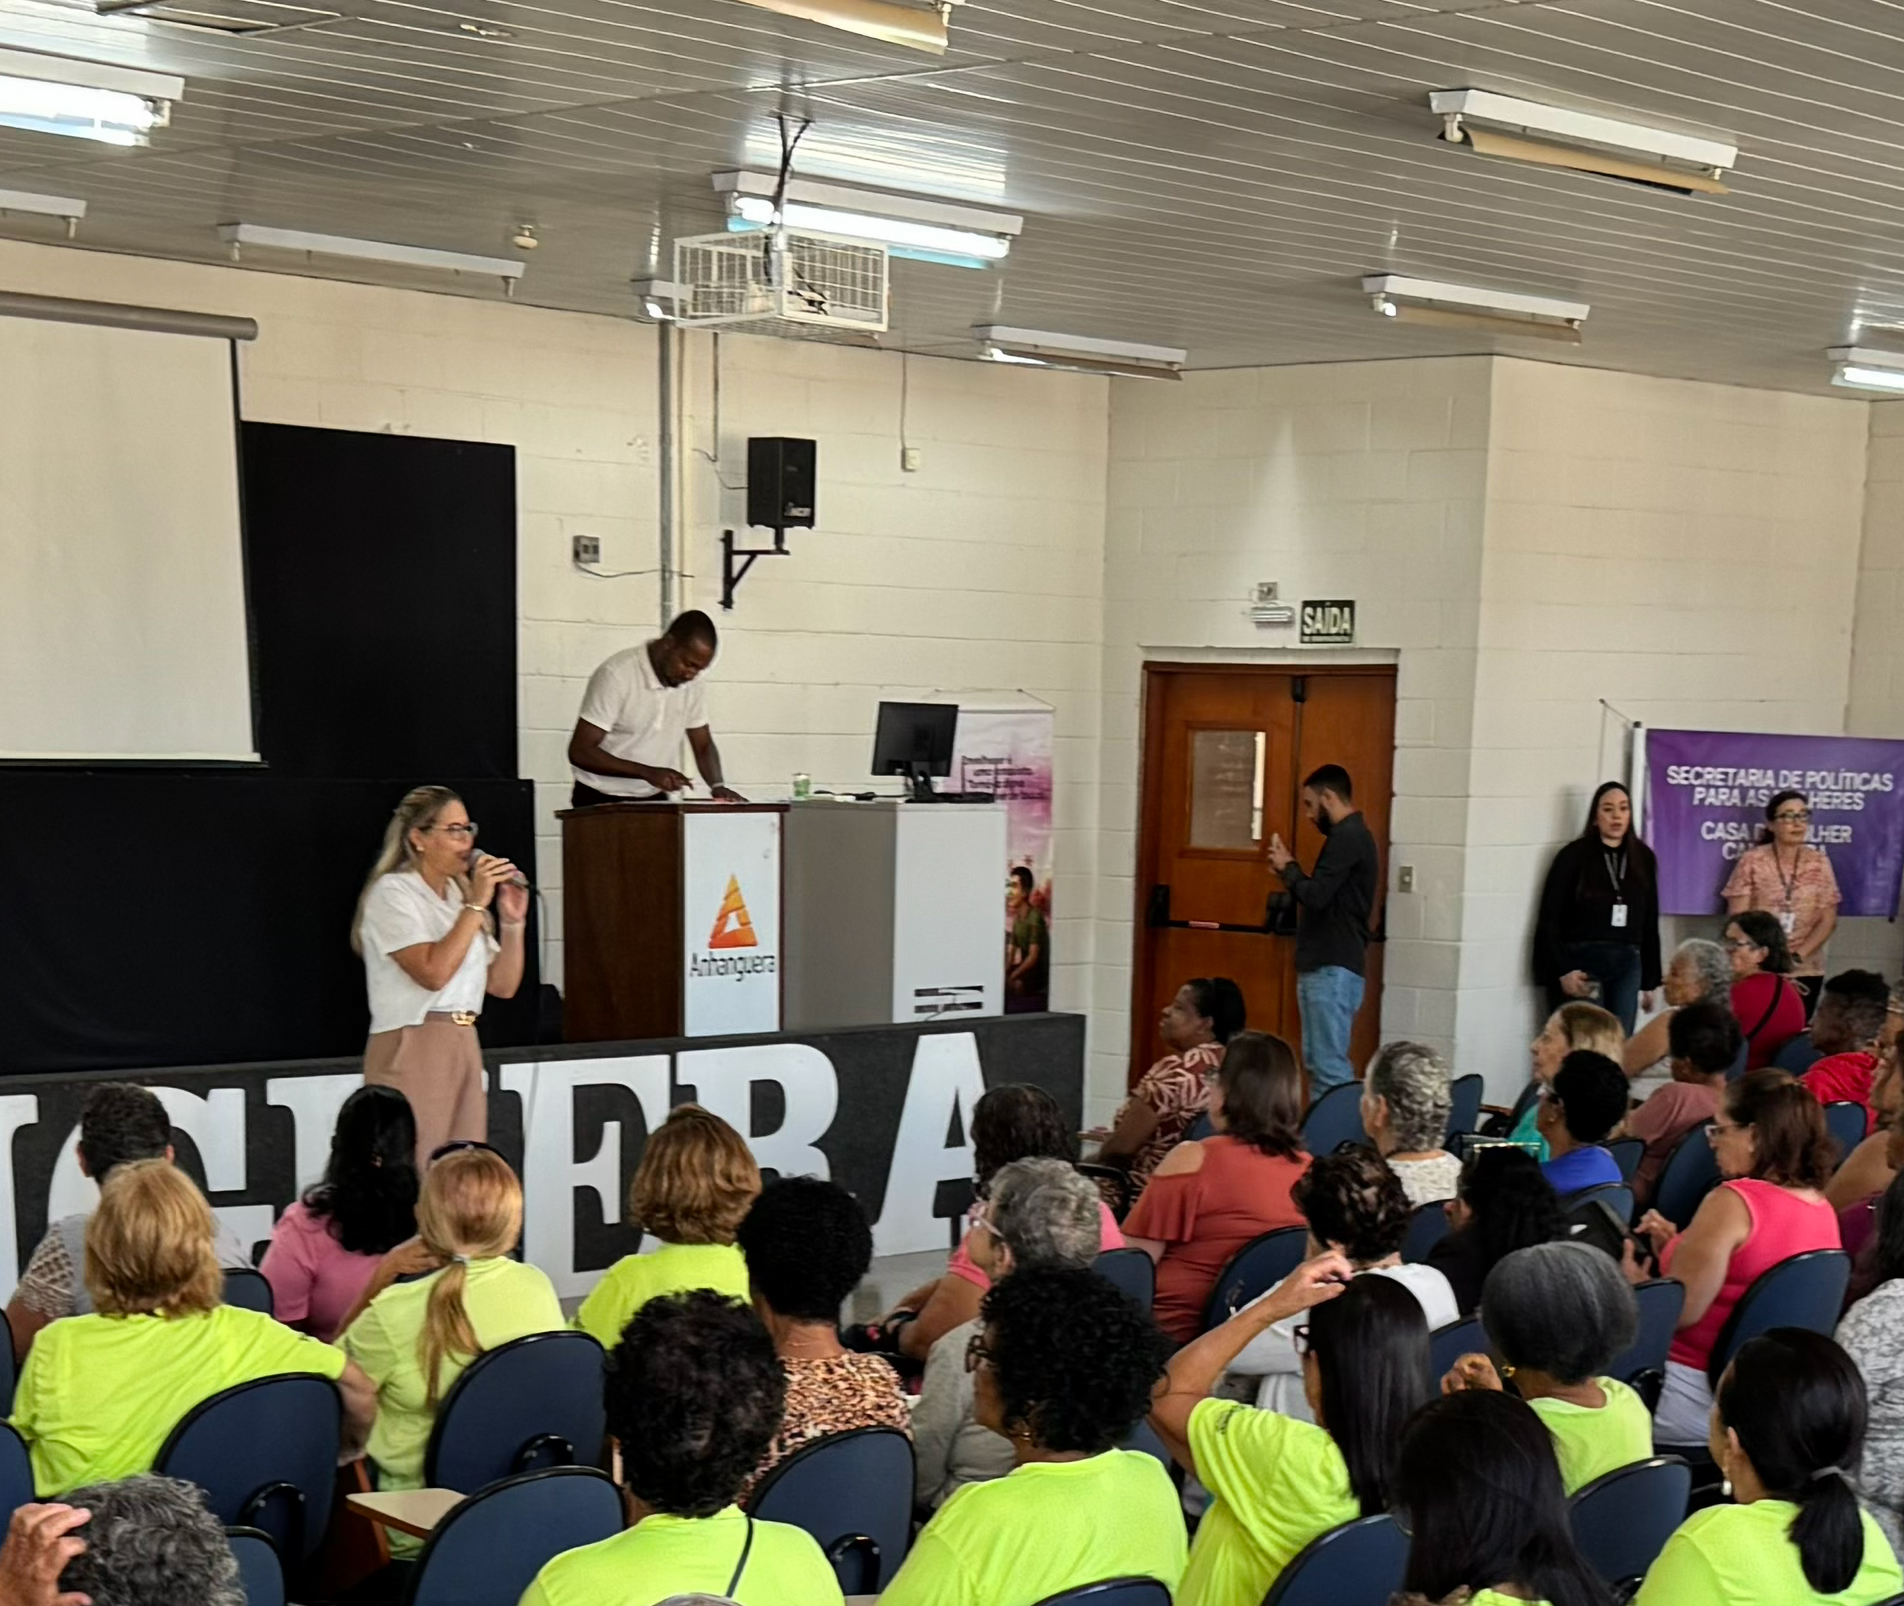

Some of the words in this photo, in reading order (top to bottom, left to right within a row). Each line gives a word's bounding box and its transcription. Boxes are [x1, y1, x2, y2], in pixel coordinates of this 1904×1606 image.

[1303, 602, 1351, 634] SAÍDA
[1666, 765, 1776, 788] SECRETARIA
[1778, 769, 1803, 789] DE
[1805, 768, 1894, 792] POLÍTICAS
[1692, 786, 1742, 807] PARA
[1745, 788, 1771, 808] AS
[1700, 821, 1751, 841] CASA
[1804, 825, 1853, 843] LHER
